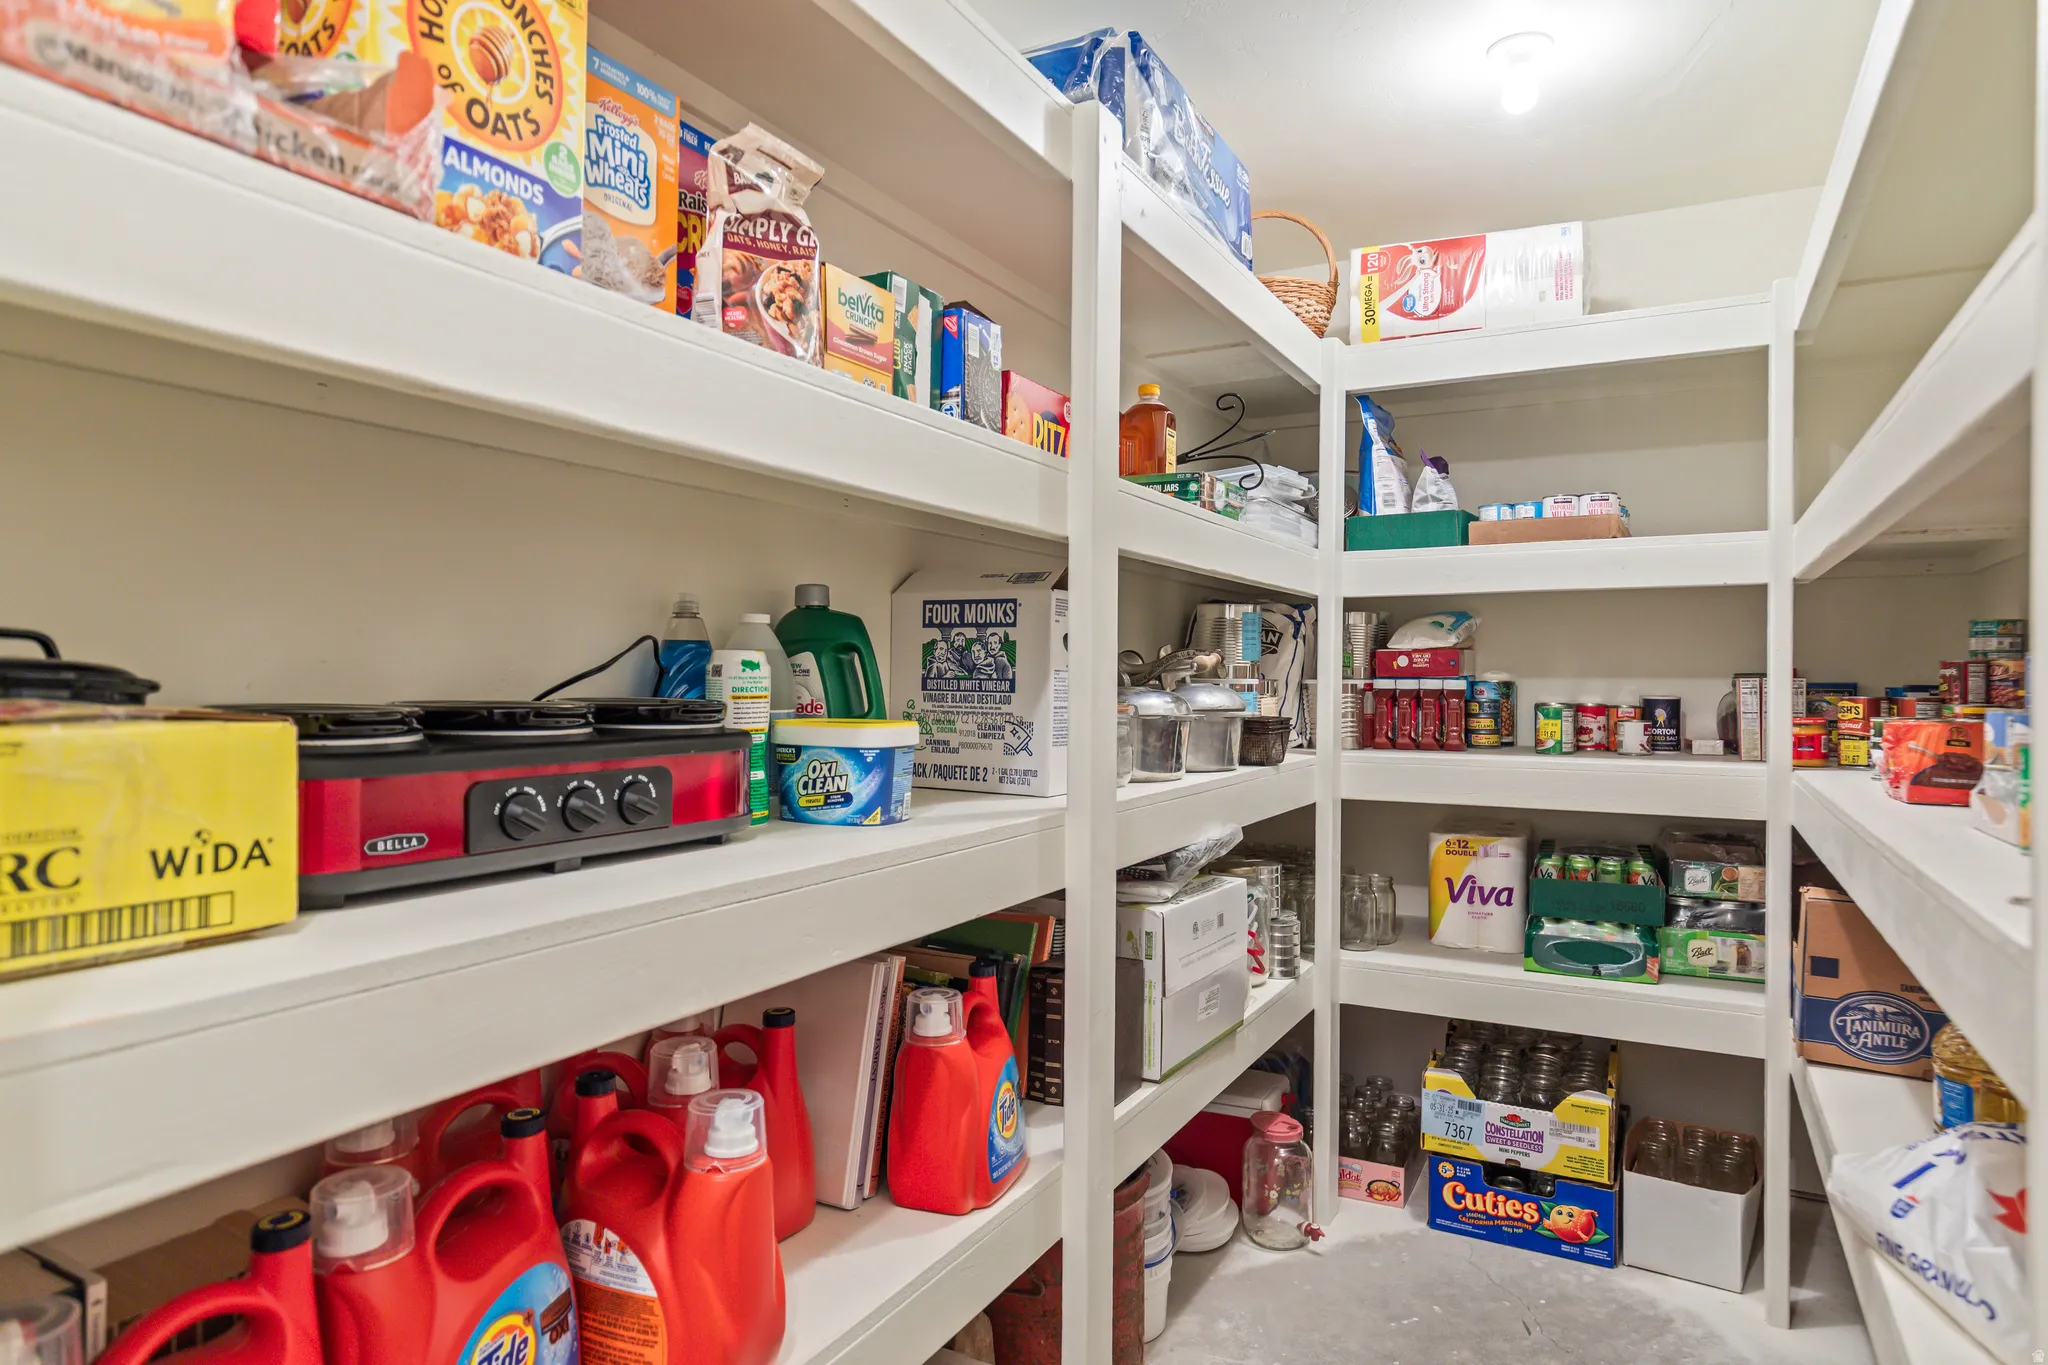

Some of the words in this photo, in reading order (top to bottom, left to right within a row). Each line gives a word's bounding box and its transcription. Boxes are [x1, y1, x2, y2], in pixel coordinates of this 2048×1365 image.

[466, 97, 541, 141] OATS
[597, 117, 638, 149] Frosted
[587, 131, 646, 180] Mini
[444, 145, 544, 206] ALMONDS
[585, 158, 649, 208] Wheats
[603, 192, 633, 212] ORIGINAL
[723, 213, 794, 243] SIMPLY
[756, 238, 791, 255] HONEY,
[1367, 253, 1378, 273] 120
[838, 287, 884, 323] belVita
[845, 309, 877, 330] CRUNCHY
[833, 336, 858, 351] Cinnamon
[858, 346, 873, 357] Brown
[873, 350, 887, 362] Sugar
[1032, 412, 1066, 457] RITZ
[1163, 483, 1179, 492] JARS
[925, 602, 960, 625] FOUR
[964, 602, 1015, 624] MONKS
[926, 679, 958, 691] DISTILLED
[959, 679, 980, 691] WHITE
[981, 680, 1010, 692] VINEGAR
[922, 692, 948, 704] VINAGRE
[951, 693, 975, 704] BLANCO
[977, 693, 1012, 705] DESTILADO
[1840, 705, 1860, 716] SH'S
[937, 726, 957, 734] COCINA
[977, 724, 1006, 732] CLEANING
[977, 731, 1005, 741] LIMPIEZA
[925, 738, 950, 747] CANNING
[931, 745, 960, 755] ENLATADO
[808, 760, 838, 780] OXI
[970, 766, 981, 781] DE
[982, 768, 987, 782] 2
[1022, 769, 1038, 778] BOTTLES
[567, 780, 578, 790] LOW
[623, 775, 633, 784] LOW
[798, 774, 848, 796] CLEAN
[505, 787, 517, 797] LOW
[376, 837, 418, 851] BELLA
[1445, 849, 1477, 857] DOUBLE
[1540, 869, 1553, 880] V8
[1642, 875, 1656, 886] V8
[1687, 876, 1708, 886] Ball
[1445, 876, 1514, 907] Viva
[1691, 947, 1714, 959] Ball
[1836, 1015, 1921, 1040] TANIMURA
[1856, 1032, 1909, 1050] ANTLE
[999, 1092, 1016, 1133] Tide
[1430, 1101, 1454, 1115] 05-31-25
[1444, 1121, 1473, 1141] 7367
[1485, 1121, 1544, 1143] CONSTELLATION
[1486, 1136, 1506, 1146] SWEET
[1512, 1140, 1543, 1153] SEEDLESS
[1511, 1149, 1530, 1158] PEPPERS
[1441, 1164, 1447, 1174] 5
[1442, 1181, 1541, 1224] Cuties
[1458, 1214, 1494, 1226] CALIFORNIA
[1494, 1219, 1532, 1230] MANDARINS
[1876, 1231, 1905, 1266] FINE
[549, 1315, 569, 1344] OXI
